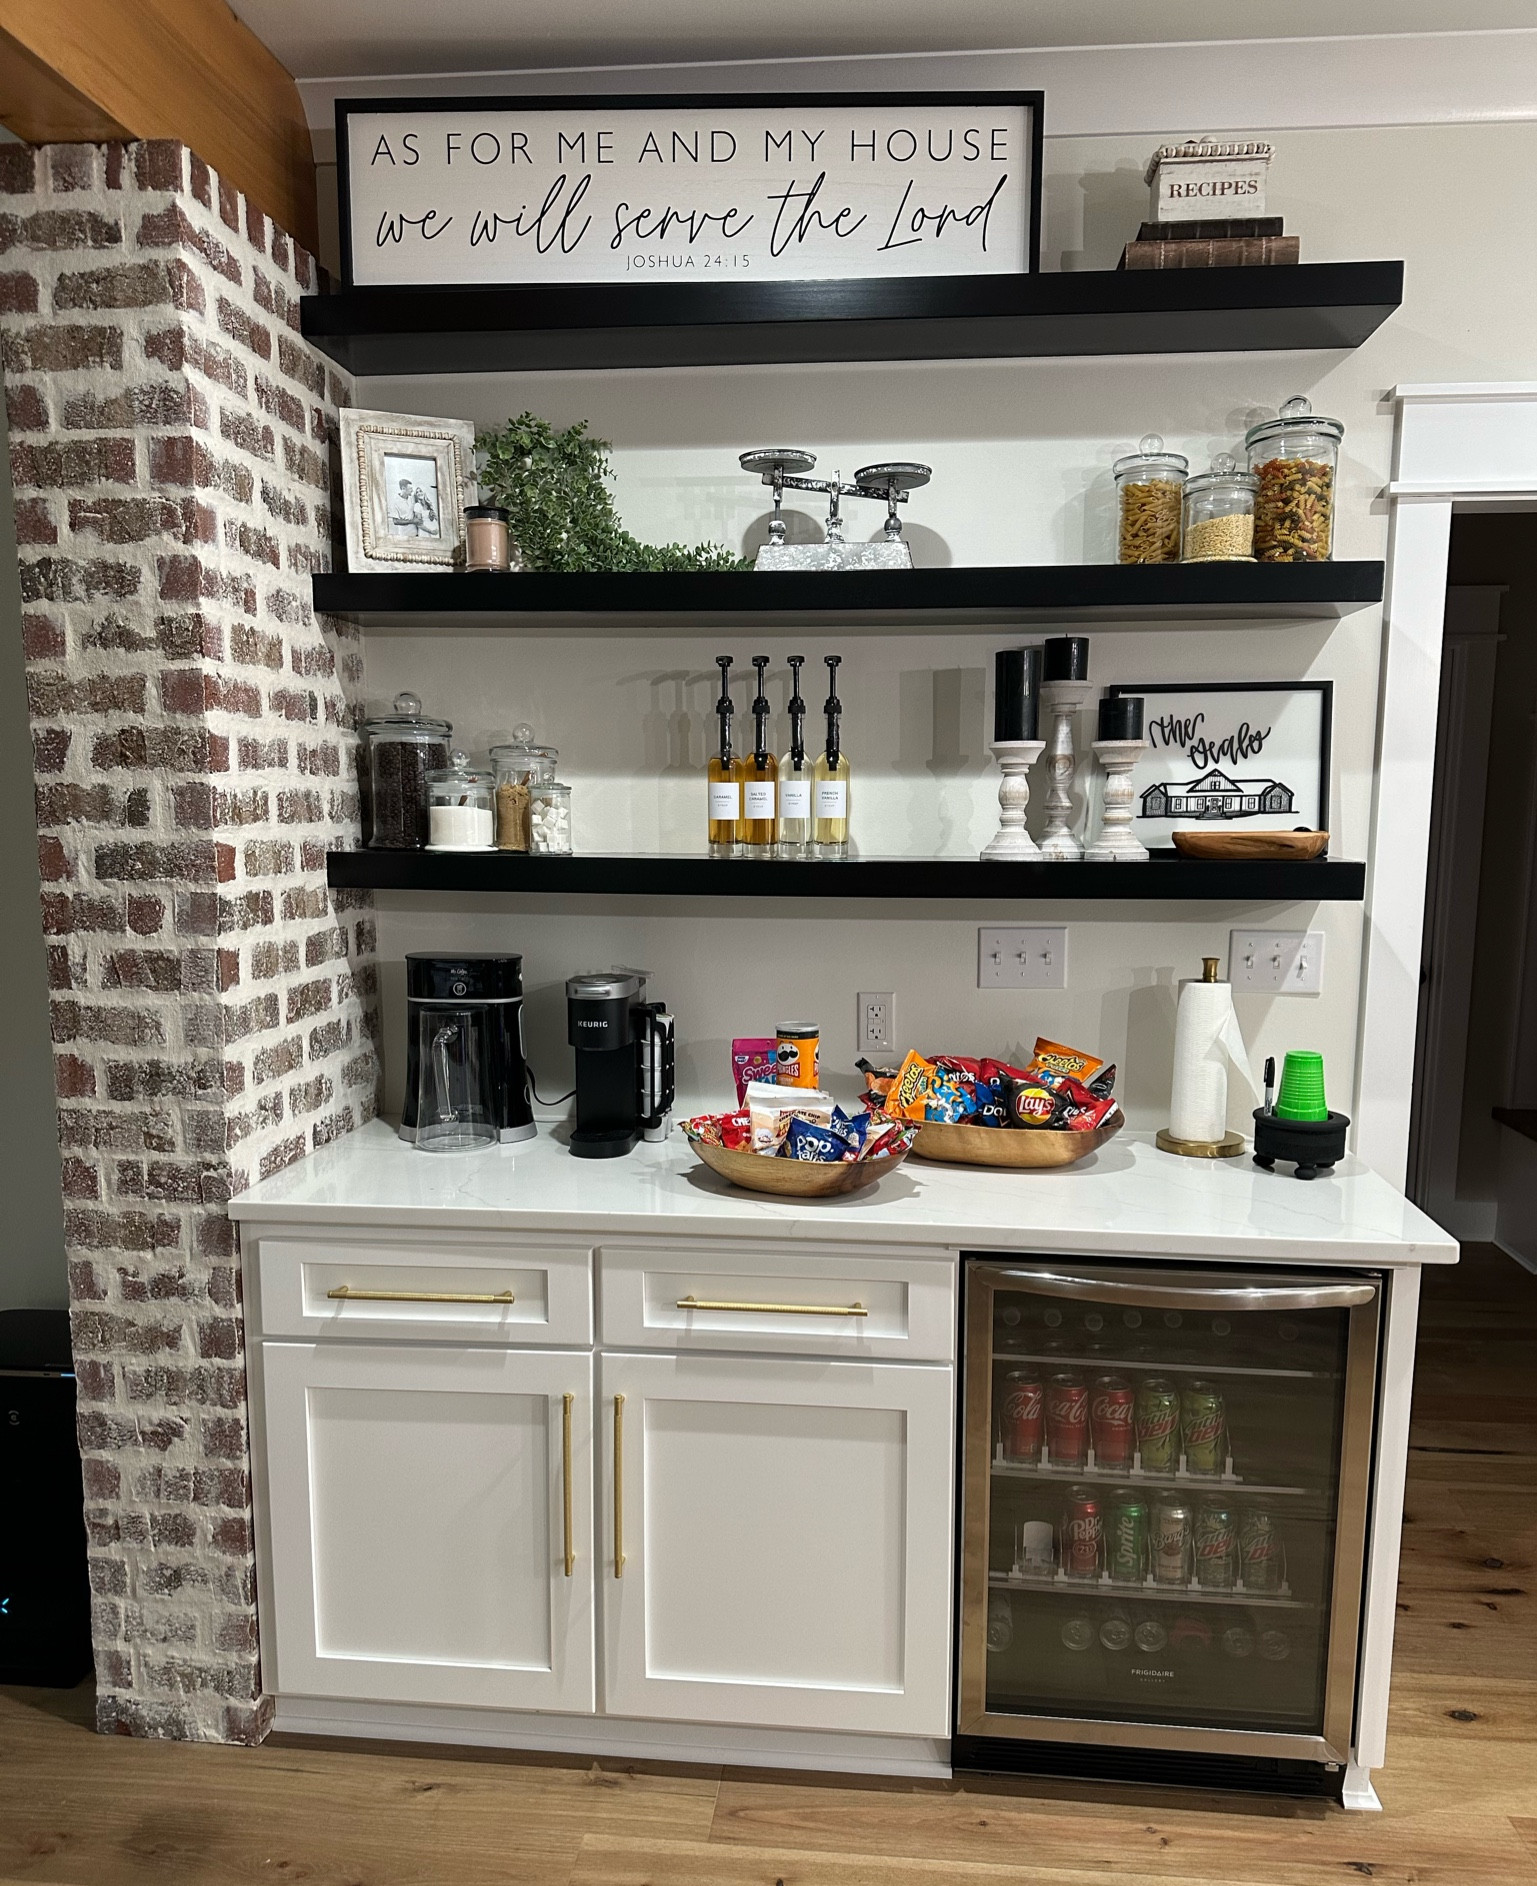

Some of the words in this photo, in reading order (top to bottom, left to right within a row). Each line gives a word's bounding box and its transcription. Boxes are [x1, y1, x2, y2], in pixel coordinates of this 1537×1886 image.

[371, 133, 420, 166] AS
[447, 132, 533, 165] FOR
[558, 131, 615, 164] ME
[638, 130, 737, 164] AND
[765, 130, 825, 163] MY
[851, 128, 1008, 162] HOUSE
[1168, 179, 1258, 199] RECIPES
[376, 209, 453, 247] we
[470, 173, 593, 254] will
[610, 202, 754, 250] serve
[767, 171, 867, 257] the
[877, 173, 1008, 252] Lord
[626, 254, 695, 271] JOSHUA
[704, 254, 750, 268] 24:15
[1149, 712, 1205, 748] the
[577, 1020, 608, 1028] KEURIG
[1116, 1516, 1137, 1567] Sprite
[1131, 1668, 1175, 1678] FRIGIDAIRE
